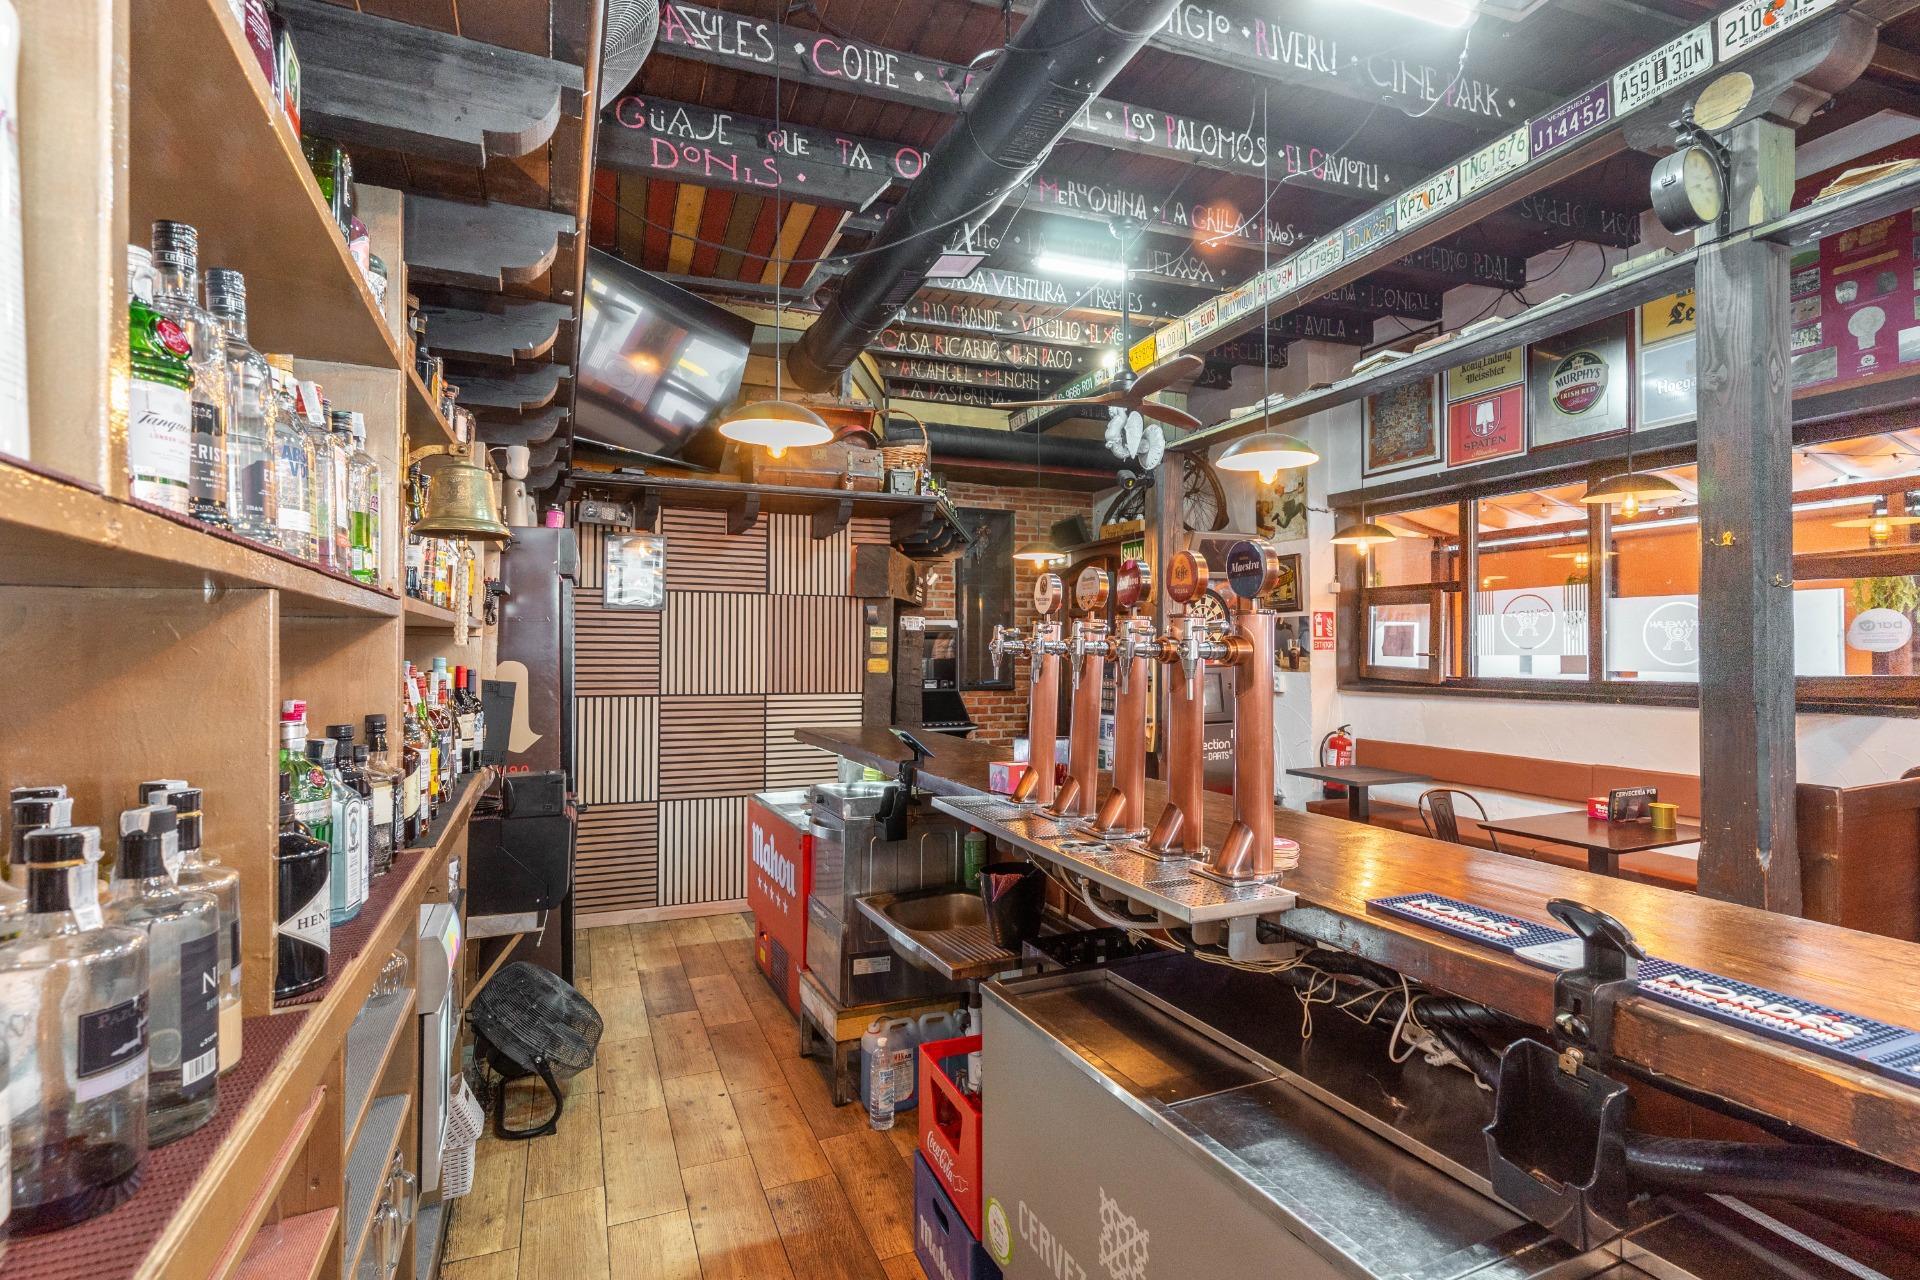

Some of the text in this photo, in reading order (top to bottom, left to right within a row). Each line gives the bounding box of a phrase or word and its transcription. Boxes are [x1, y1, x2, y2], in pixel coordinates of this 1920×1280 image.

[1744, 6, 1809, 45] SUNSHINE STATE
[813, 39, 900, 88] COIPE
[1638, 41, 1683, 69] FLORIDA
[1367, 56, 1438, 101] CINE
[1445, 73, 1502, 117] PARK
[1621, 70, 1650, 104] A59
[1547, 95, 1591, 122] VENEZUELA
[767, 130, 810, 156] QUE
[836, 138, 873, 170] TA
[1122, 104, 1156, 143] LOS
[1165, 114, 1267, 167] PALOMOS
[1285, 144, 1307, 176] EL
[1309, 147, 1379, 191] GAVIOTU
[1491, 132, 1526, 167] 1876
[1161, 202, 1188, 227] LA
[1192, 204, 1250, 238] GRILLA
[991, 271, 1068, 303] VENTURA
[951, 305, 1003, 332] GRANDE
[1019, 314, 1081, 341] VIRGILIO
[1200, 308, 1215, 326] ELVIS
[880, 329, 930, 354] CASA
[935, 335, 1000, 361] RICARDO
[1012, 344, 1038, 367] DON
[1041, 345, 1073, 370] PACO
[900, 358, 973, 384] ARCANGEL
[1560, 385, 1596, 400] IRISH RED
[1463, 433, 1507, 452] SPATEN
[1231, 558, 1261, 574] Maestra
